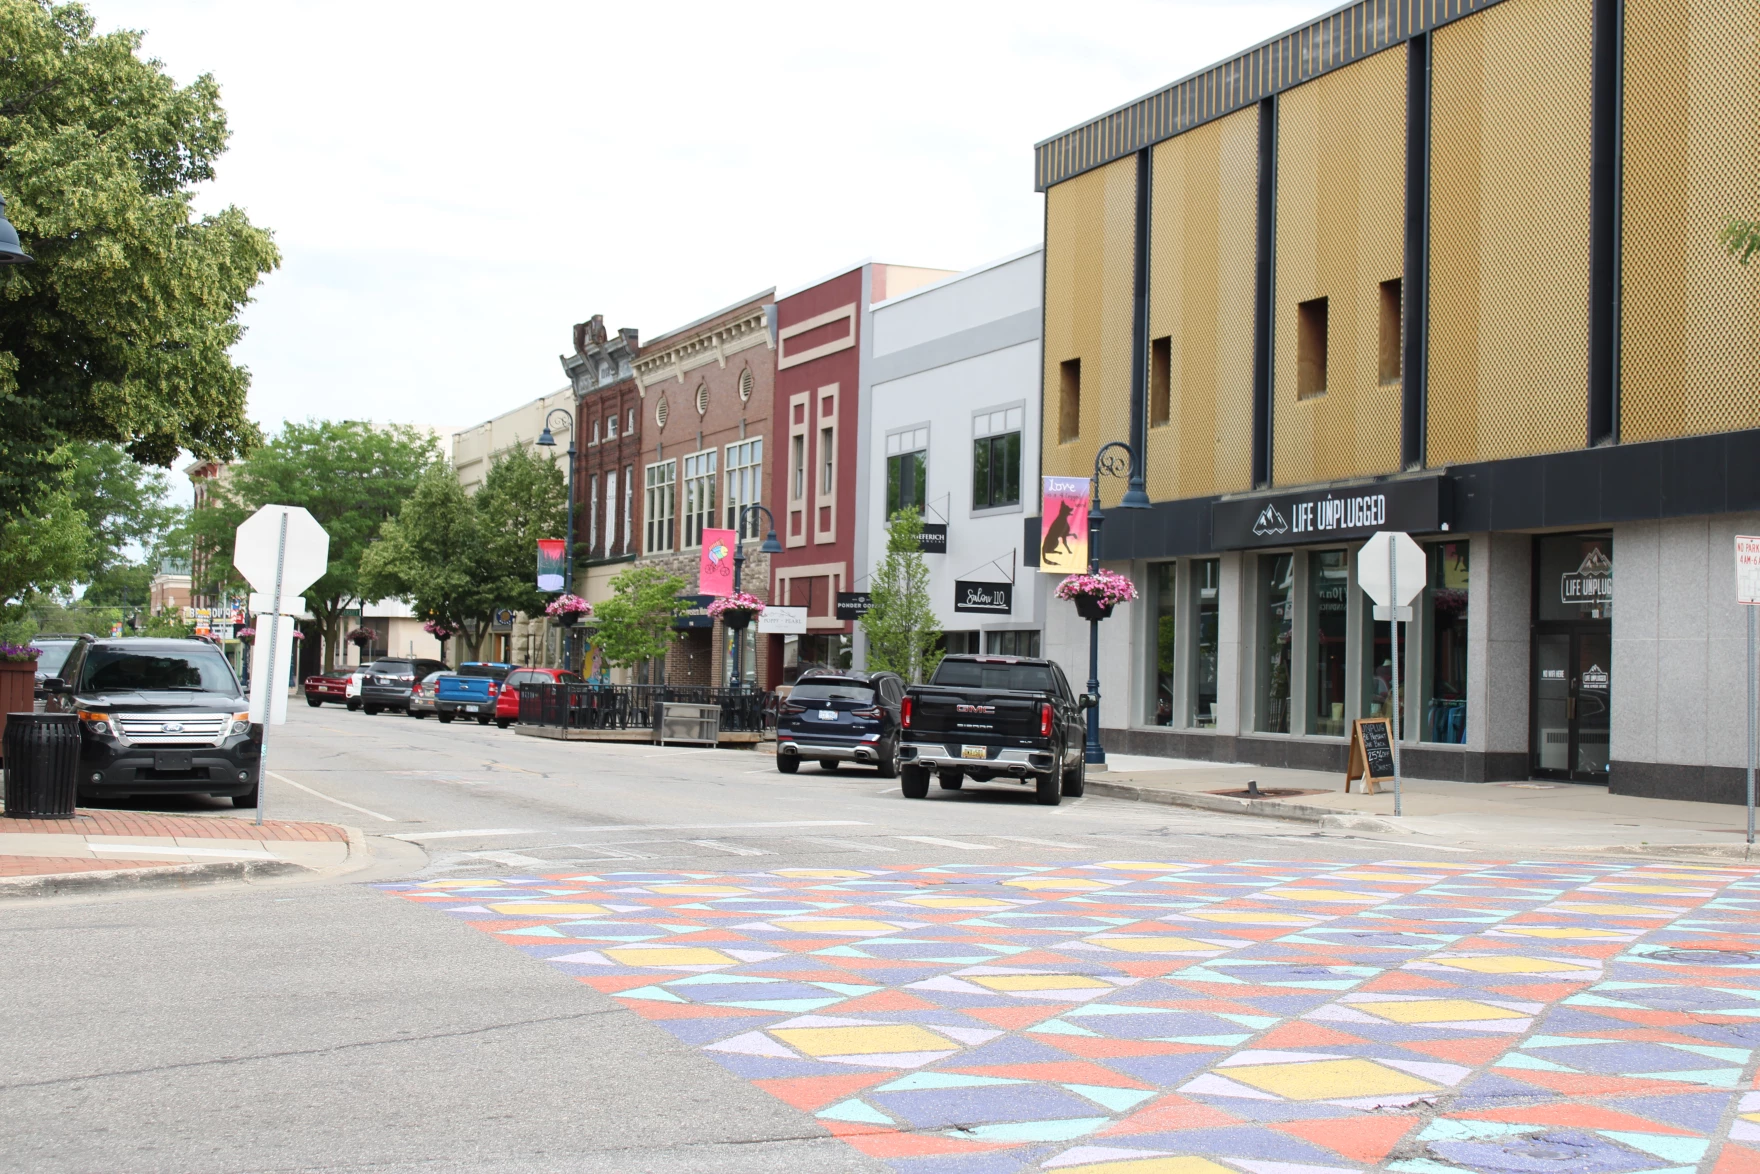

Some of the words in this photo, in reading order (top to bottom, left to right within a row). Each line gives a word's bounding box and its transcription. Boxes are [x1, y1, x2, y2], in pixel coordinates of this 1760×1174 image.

[1049, 479, 1076, 492] Love
[1292, 502, 1314, 533] LIFE
[1317, 494, 1385, 530] UNPLUGGED
[1737, 543, 1744, 552] NO
[1565, 579, 1581, 596] LIFE
[966, 587, 993, 605] Salon
[993, 591, 1005, 605] 110
[957, 704, 995, 714] GMC
